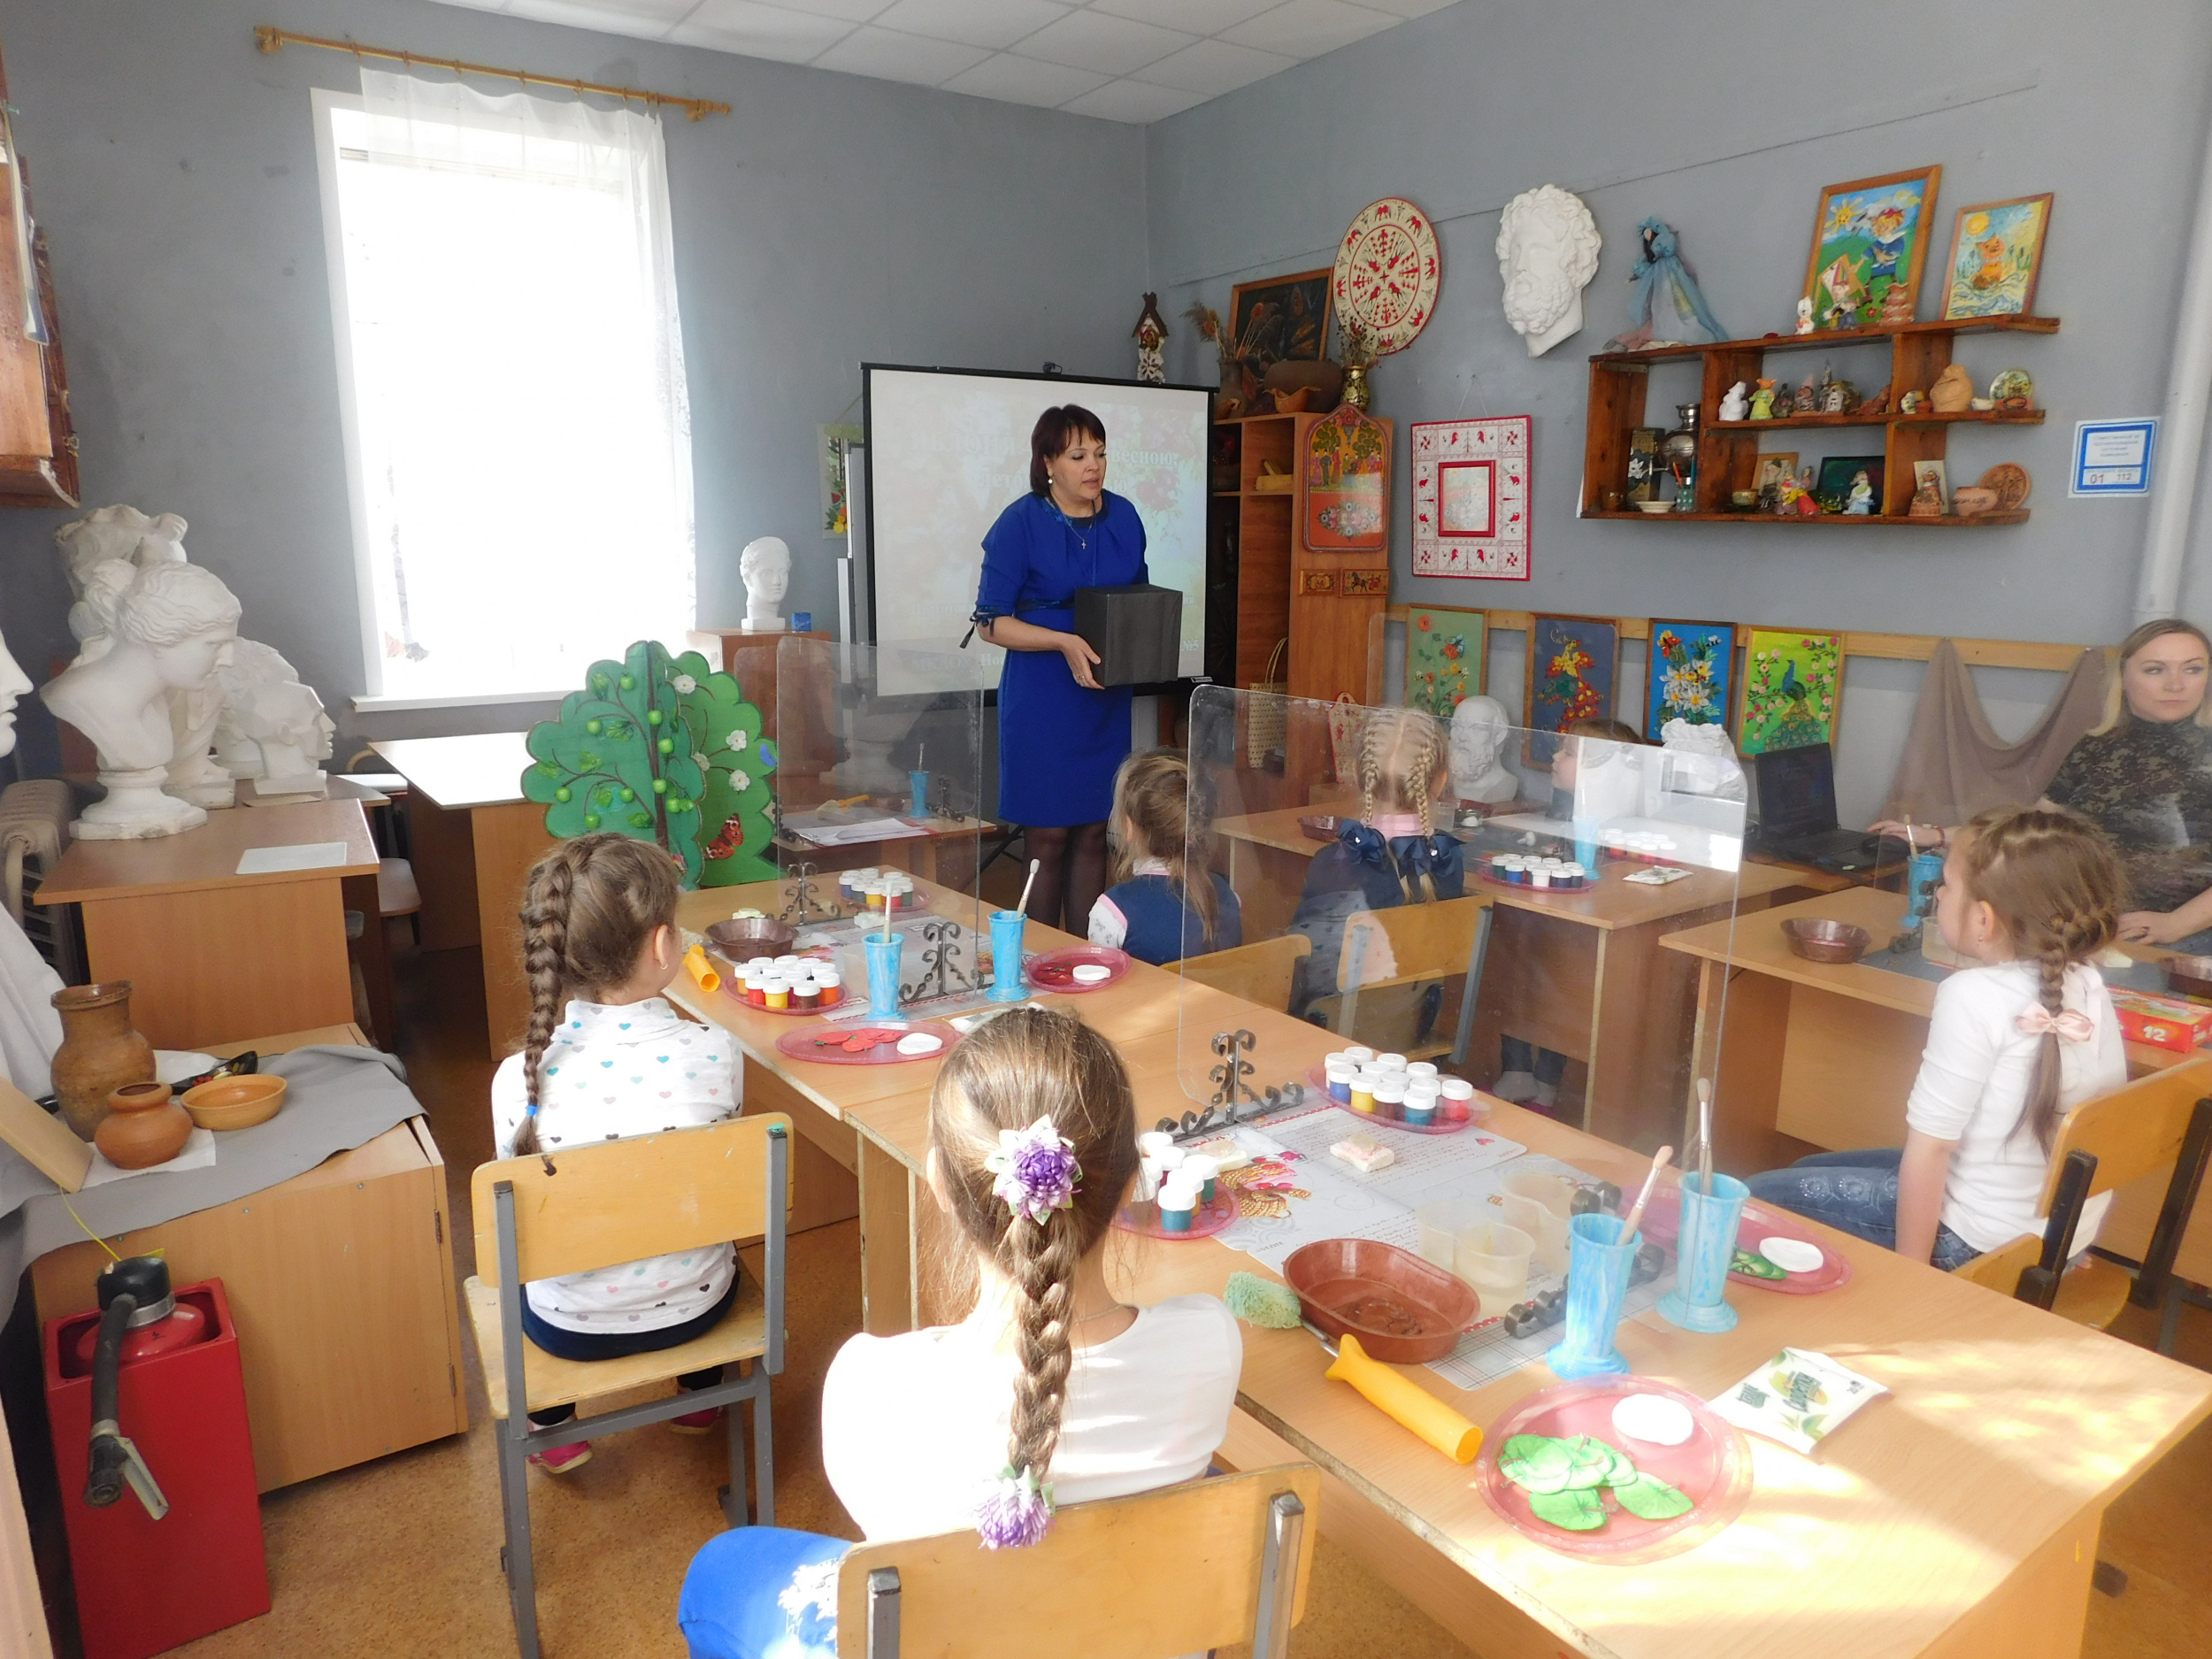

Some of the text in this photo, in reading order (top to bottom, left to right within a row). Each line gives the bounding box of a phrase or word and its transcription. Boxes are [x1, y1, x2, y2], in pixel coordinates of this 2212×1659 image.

[1110, 449, 1179, 468] весною,
[2090, 474, 2104, 484] 01
[2143, 1025, 2167, 1042] 12
